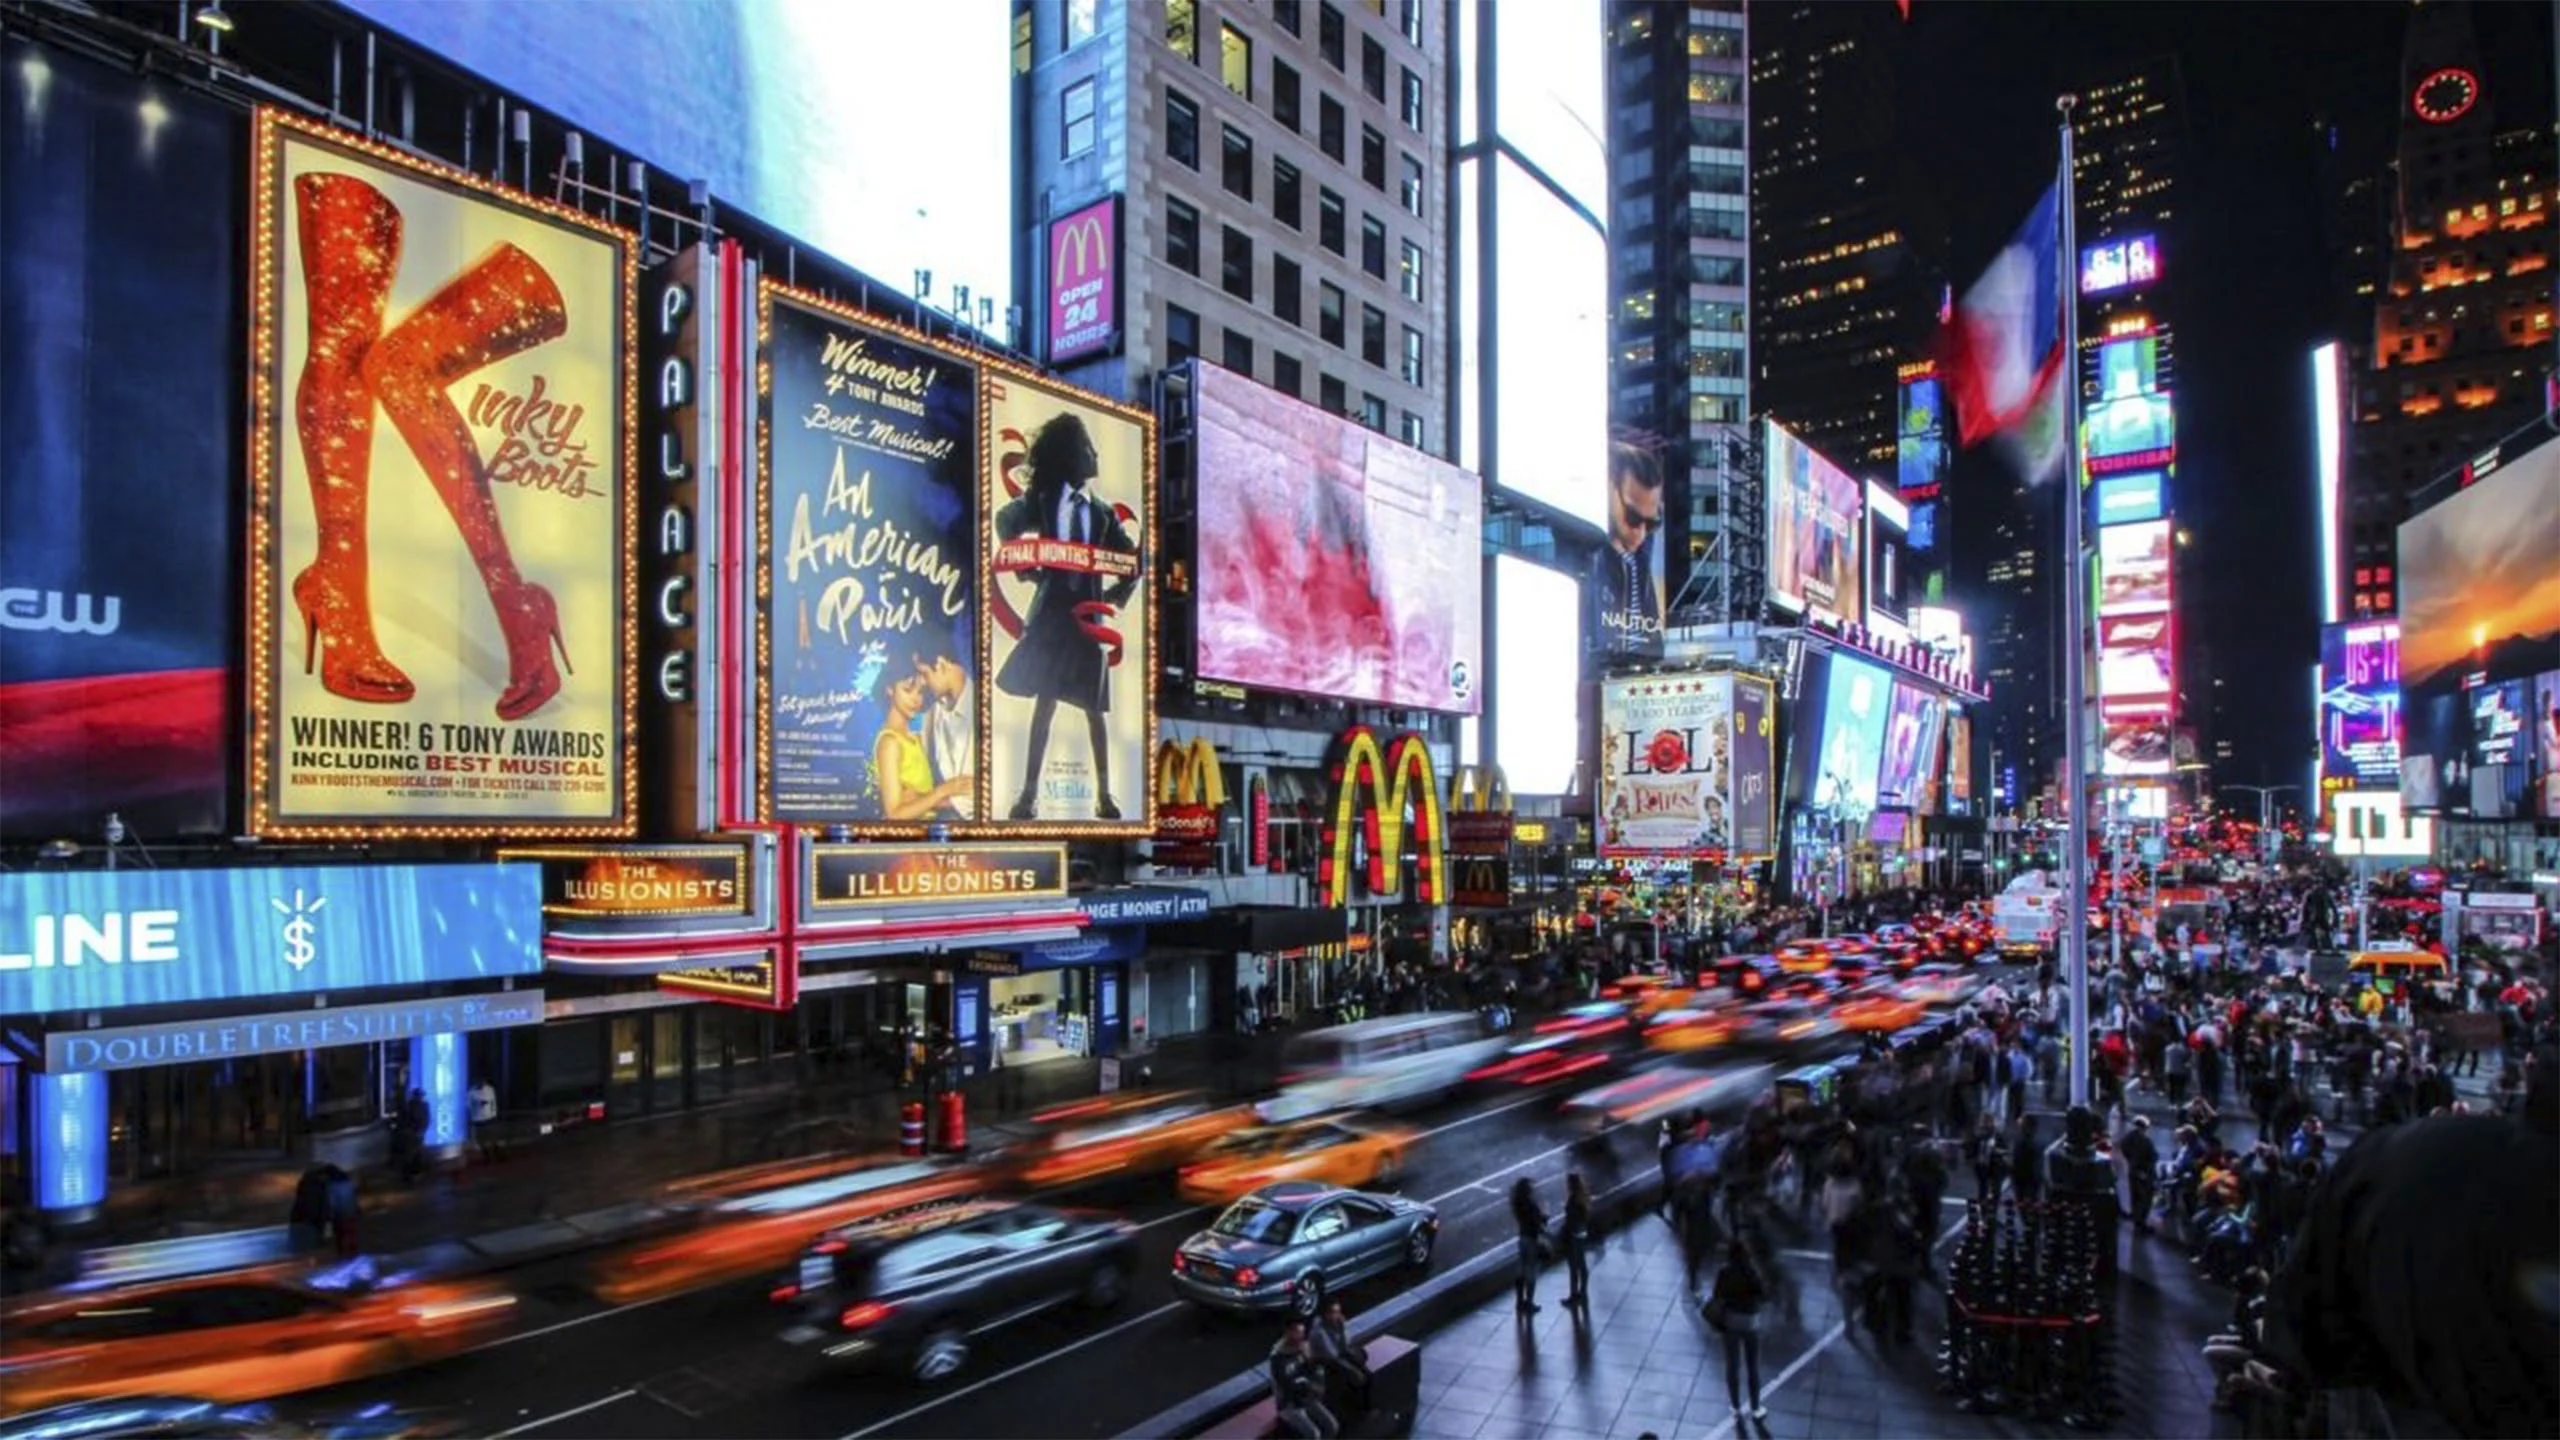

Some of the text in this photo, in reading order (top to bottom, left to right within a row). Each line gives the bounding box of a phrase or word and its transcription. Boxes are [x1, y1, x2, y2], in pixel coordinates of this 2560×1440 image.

[1059, 277, 1103, 306] OPEN
[1064, 297, 1098, 331] 24
[1054, 320, 1112, 353] HOURS
[821, 332, 937, 397] Winner!
[848, 381, 877, 404] TONY
[879, 391, 925, 417] AWARDS
[802, 403, 954, 459] Best Musical!
[486, 438, 607, 498] Boots
[2091, 448, 2171, 472] TOSHIBA
[661, 285, 687, 700] PALACE
[822, 445, 873, 518] An
[785, 493, 965, 616] American
[1000, 543, 1036, 565] FINAL
[1038, 543, 1091, 568] MONTHS
[1601, 610, 1664, 635] NAUTICA
[291, 716, 605, 759] WINNER! 6 TONY AWARDS
[291, 751, 605, 777] INCLUDING BEST MUSICAL
[622, 865, 657, 879] THE
[937, 855, 968, 868] THE
[564, 879, 734, 900] ILLUSIONISTS
[848, 869, 1037, 897] ILLUSIONISTS
[1122, 900, 1173, 917] MONEY
[1179, 897, 1208, 914] ATM
